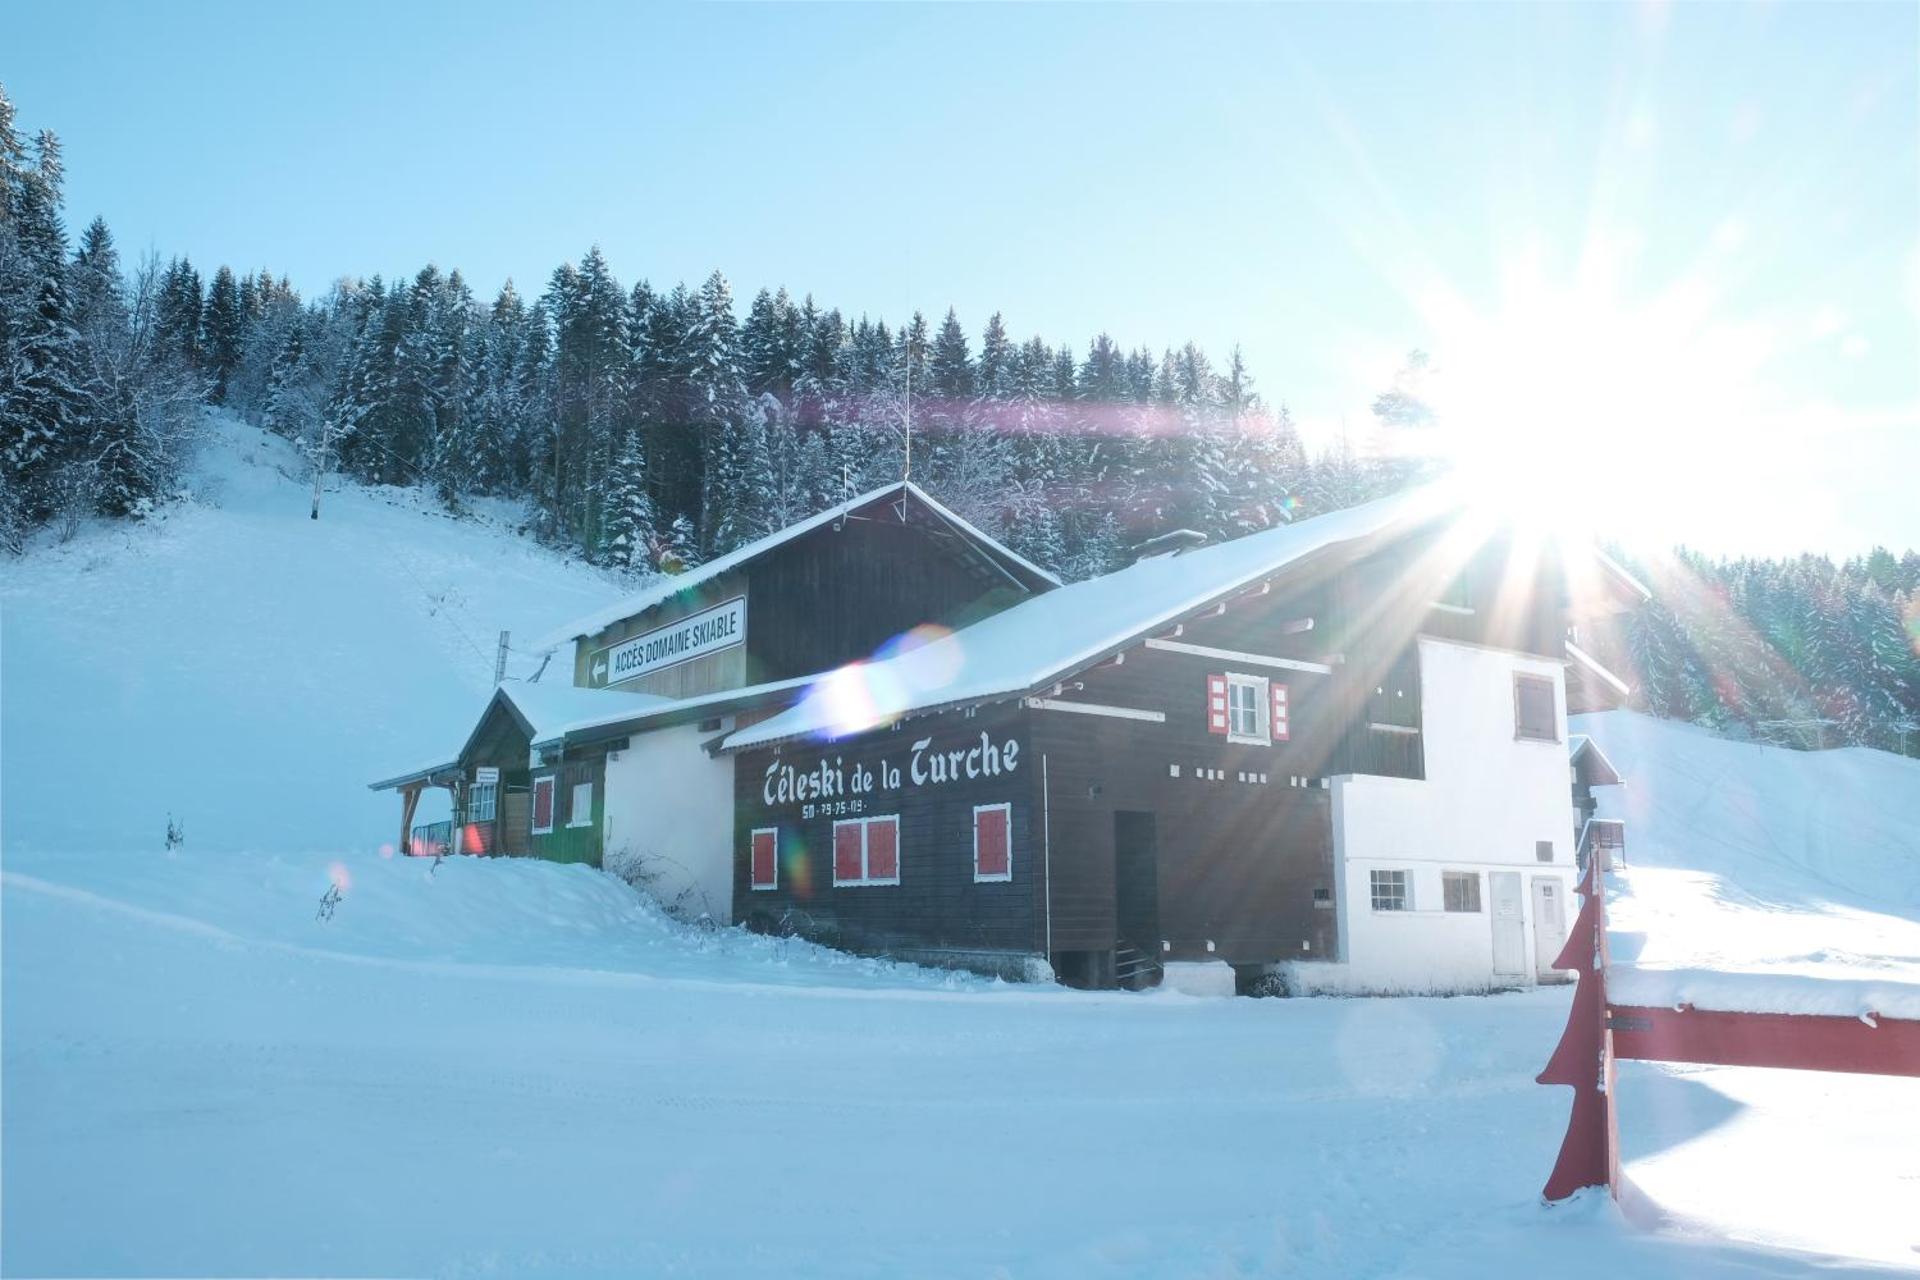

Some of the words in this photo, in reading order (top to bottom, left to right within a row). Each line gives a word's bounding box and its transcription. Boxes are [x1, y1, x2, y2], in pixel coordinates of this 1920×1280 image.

[615, 643, 644, 673] ACCÈS
[646, 628, 690, 664] DOMAINE
[693, 611, 736, 647] SKIABLE
[763, 756, 844, 805] Téleski
[851, 763, 872, 793] de
[882, 759, 901, 791] la
[910, 730, 1020, 786] Turche
